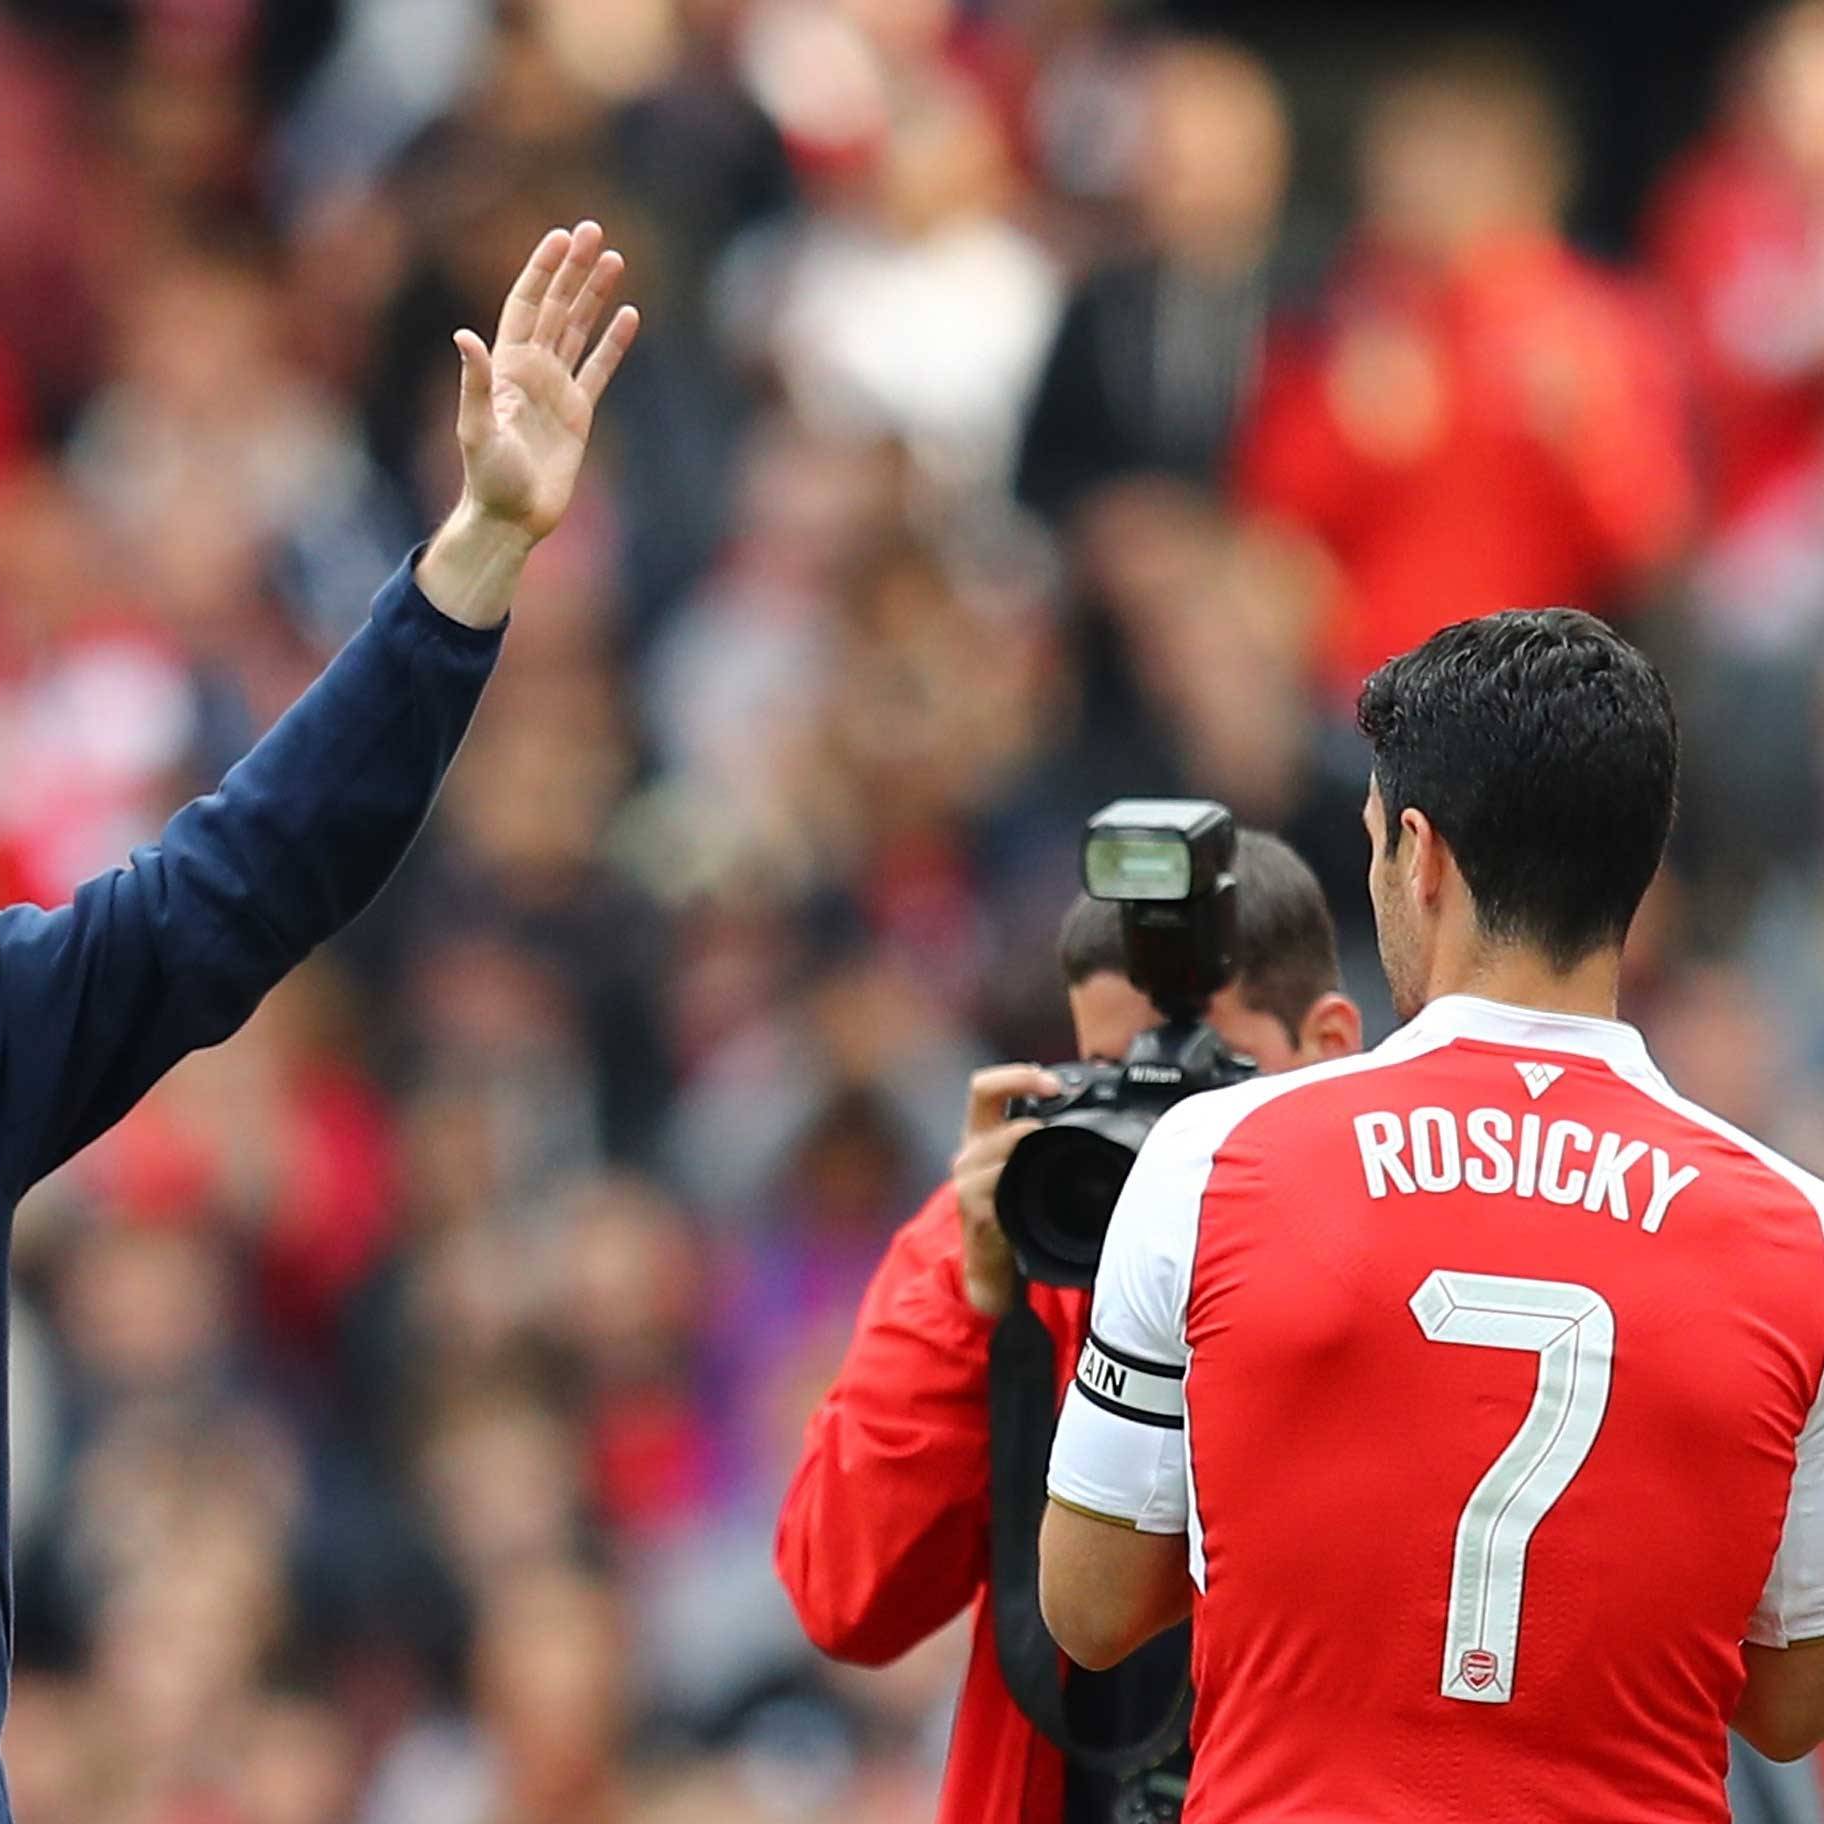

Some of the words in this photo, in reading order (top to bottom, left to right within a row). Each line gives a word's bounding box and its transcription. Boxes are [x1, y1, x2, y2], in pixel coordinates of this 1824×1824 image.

[1354, 1106, 1701, 1234] ROSICKY
[1080, 1346, 1127, 1398] AIN
[1407, 1268, 1615, 1704] 7
